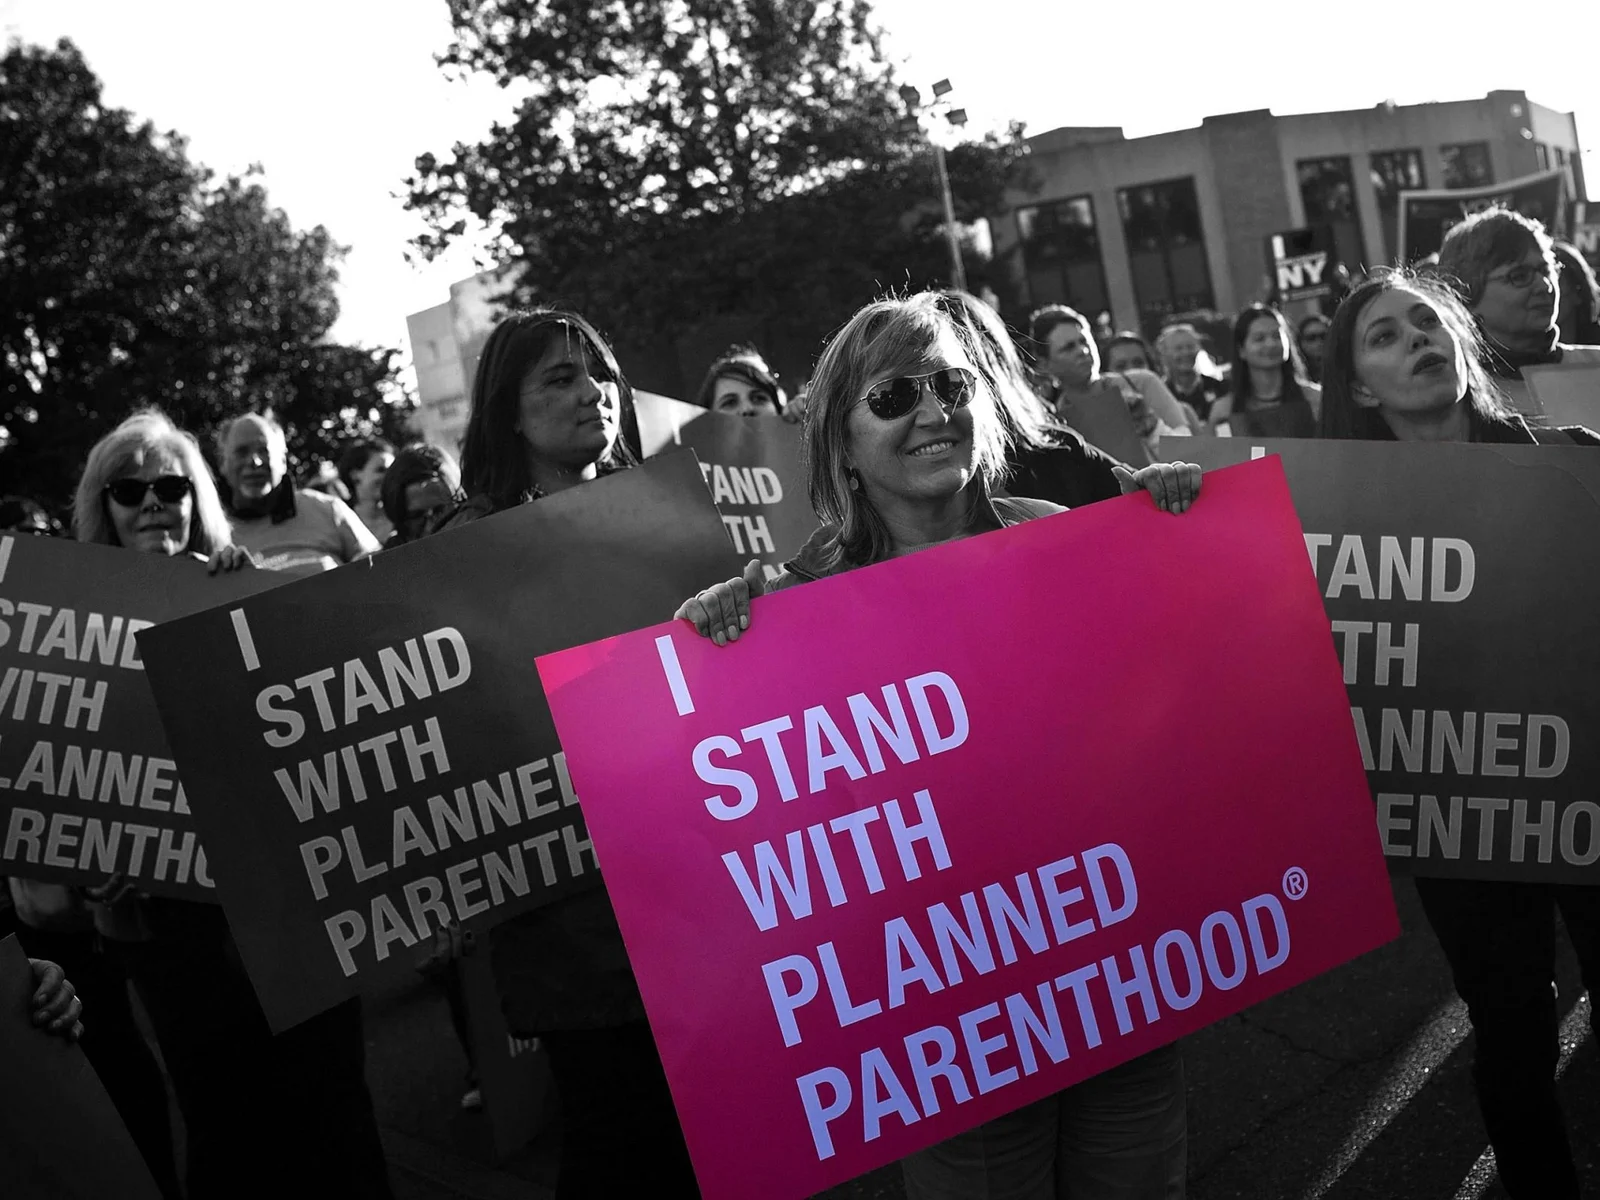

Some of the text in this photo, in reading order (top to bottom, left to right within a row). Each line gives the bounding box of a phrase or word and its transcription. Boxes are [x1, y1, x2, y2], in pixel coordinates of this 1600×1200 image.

[1277, 255, 1326, 290] NY
[699, 462, 783, 504] AND
[721, 515, 775, 554] TH
[1303, 533, 1475, 602] TAND
[230, 608, 261, 671] I
[655, 635, 695, 715] I
[1331, 620, 1419, 686] TH
[0, 667, 108, 732] ITH
[255, 627, 471, 748] STAND
[0, 735, 191, 815] ANNE
[274, 716, 451, 823] WITH
[692, 671, 970, 820] STAND
[1350, 706, 1570, 778] NNED
[3, 807, 215, 888] RENTH
[721, 789, 952, 931] WITH
[1376, 793, 1600, 866] ENTHO
[324, 825, 600, 977] PARENTH
[761, 843, 1138, 1047] PLANNED
